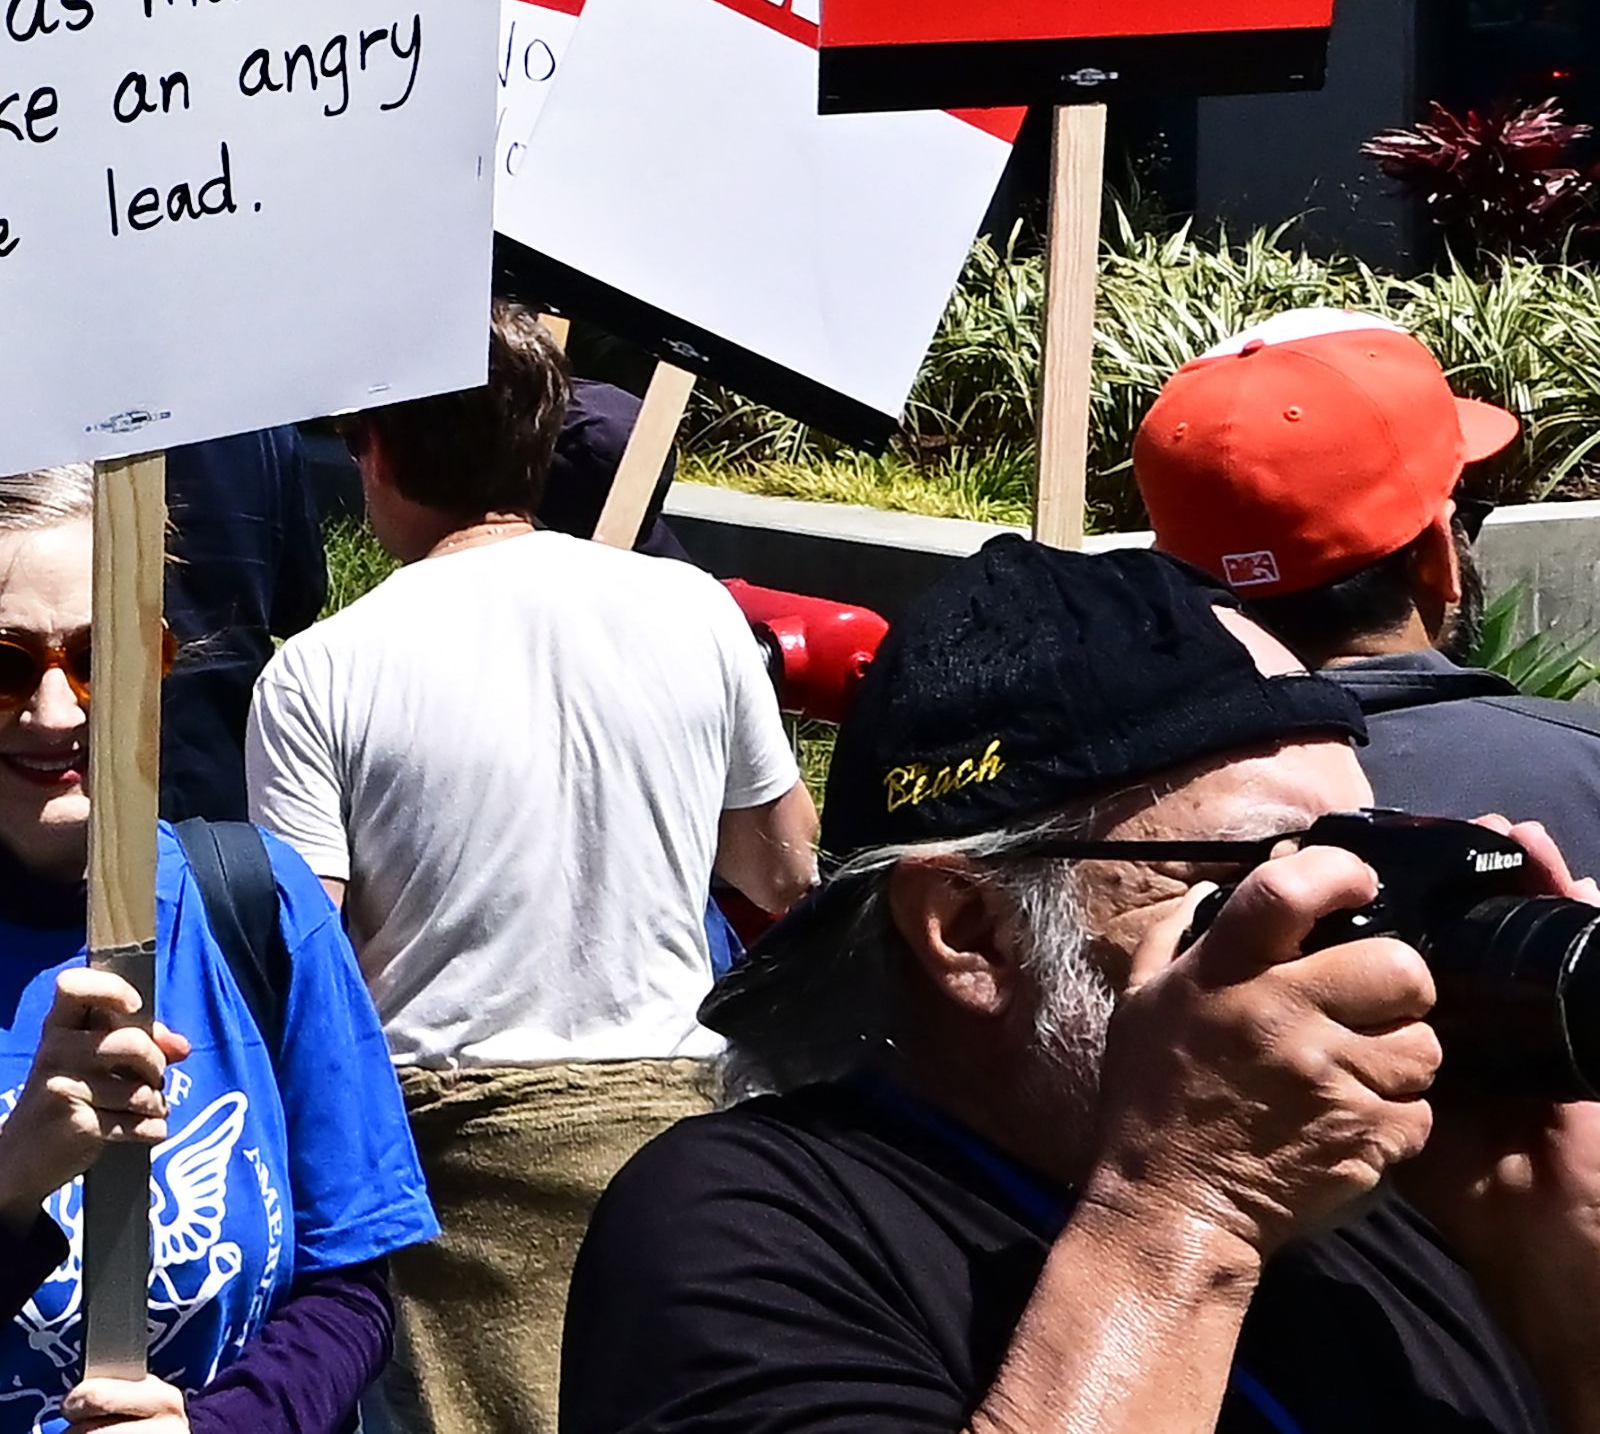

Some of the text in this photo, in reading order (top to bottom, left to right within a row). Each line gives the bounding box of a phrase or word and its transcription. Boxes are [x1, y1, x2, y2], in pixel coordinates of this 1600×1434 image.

[113, 71, 190, 124] an
[239, 13, 422, 117] angry
[107, 142, 263, 237] lead.
[883, 739, 1007, 813] Beach
[1475, 851, 1523, 872] Nikon
